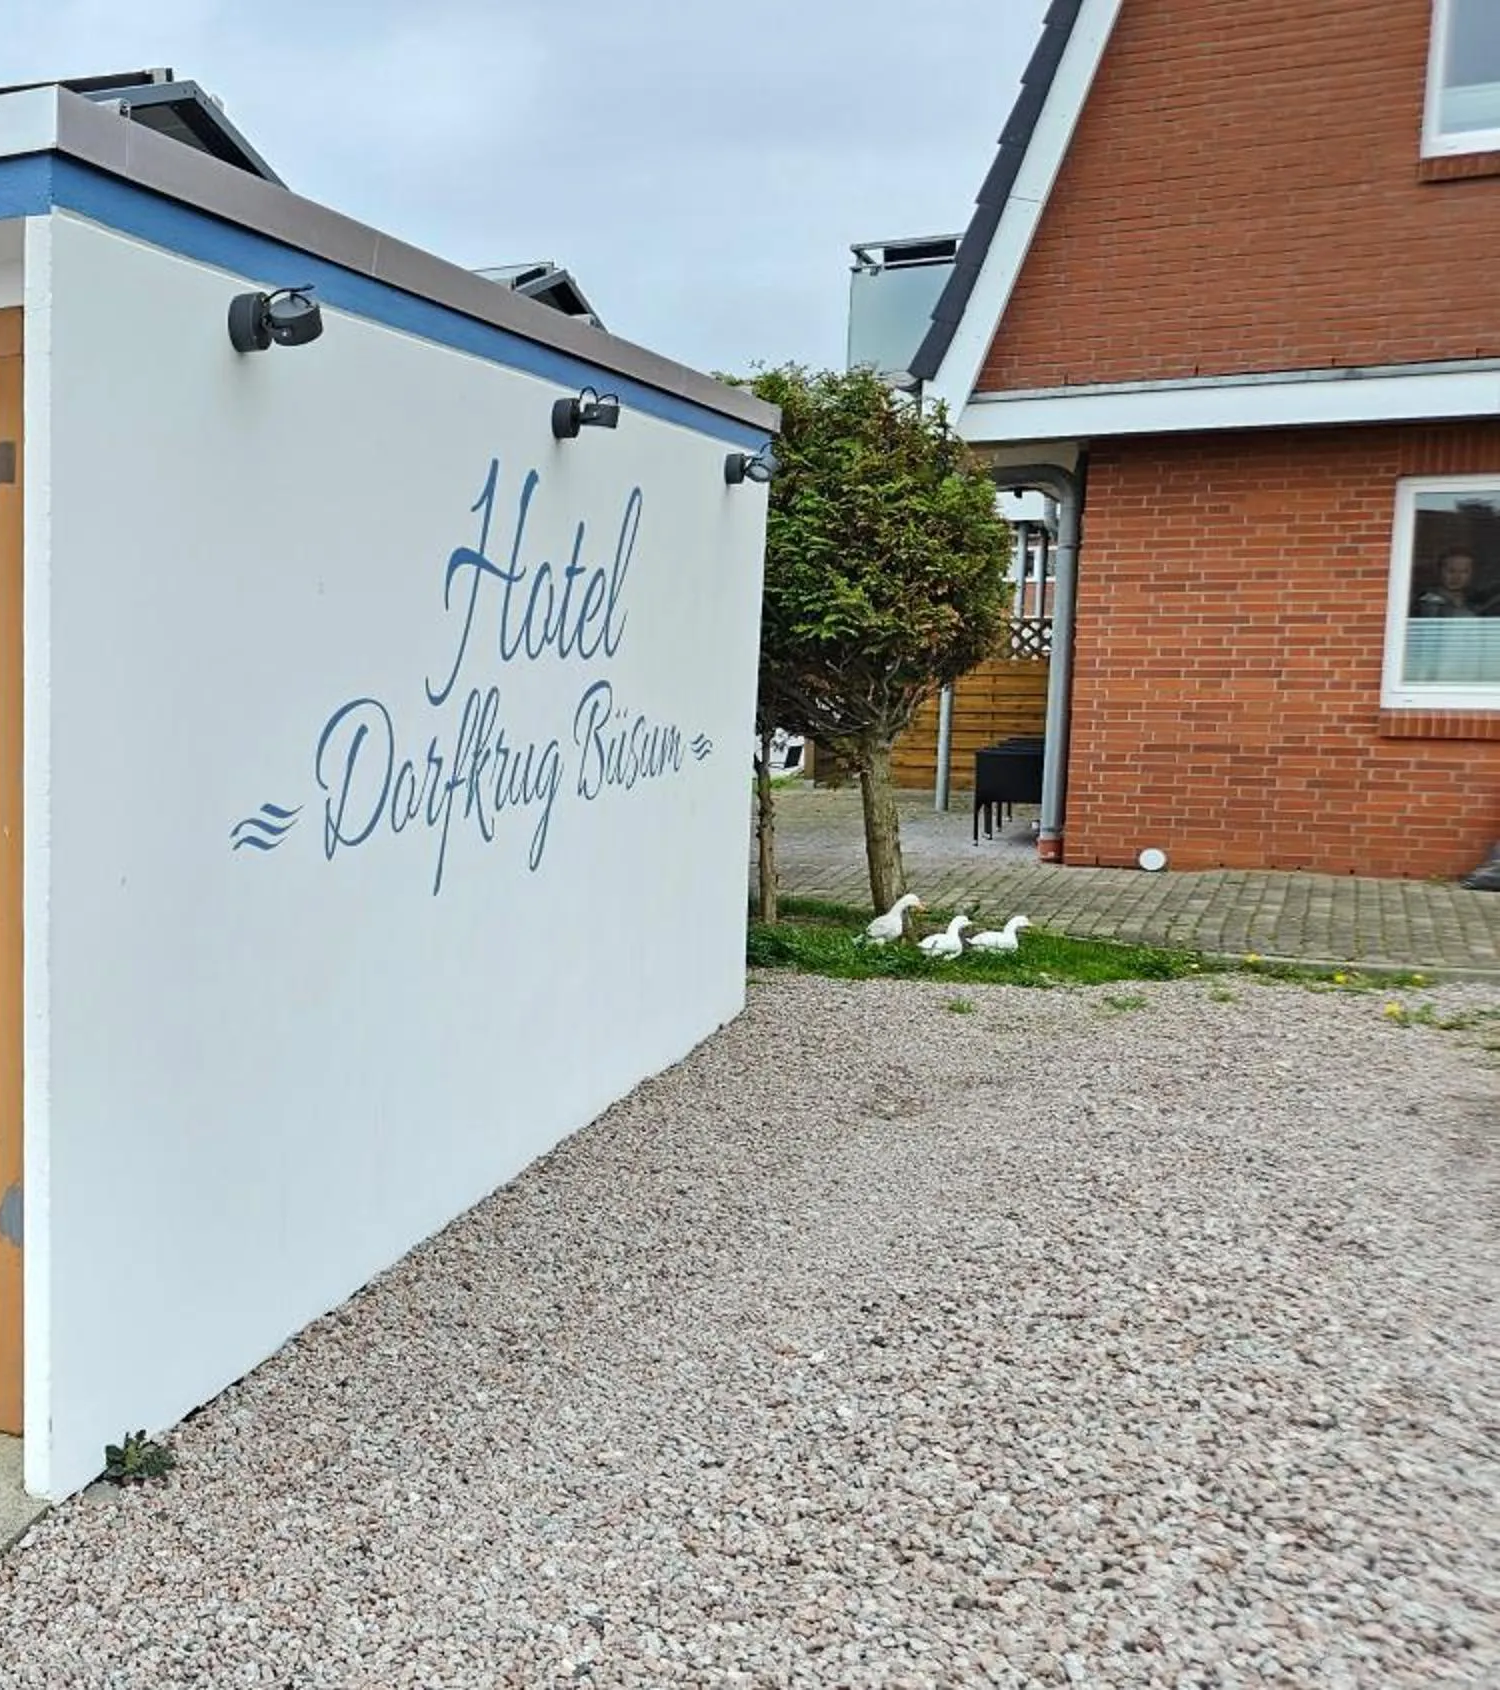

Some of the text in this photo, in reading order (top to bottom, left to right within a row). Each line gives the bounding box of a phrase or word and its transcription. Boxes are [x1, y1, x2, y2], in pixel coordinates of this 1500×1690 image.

[425, 458, 642, 705] Hotel
[315, 680, 684, 896] Dorfkrug Büsum
